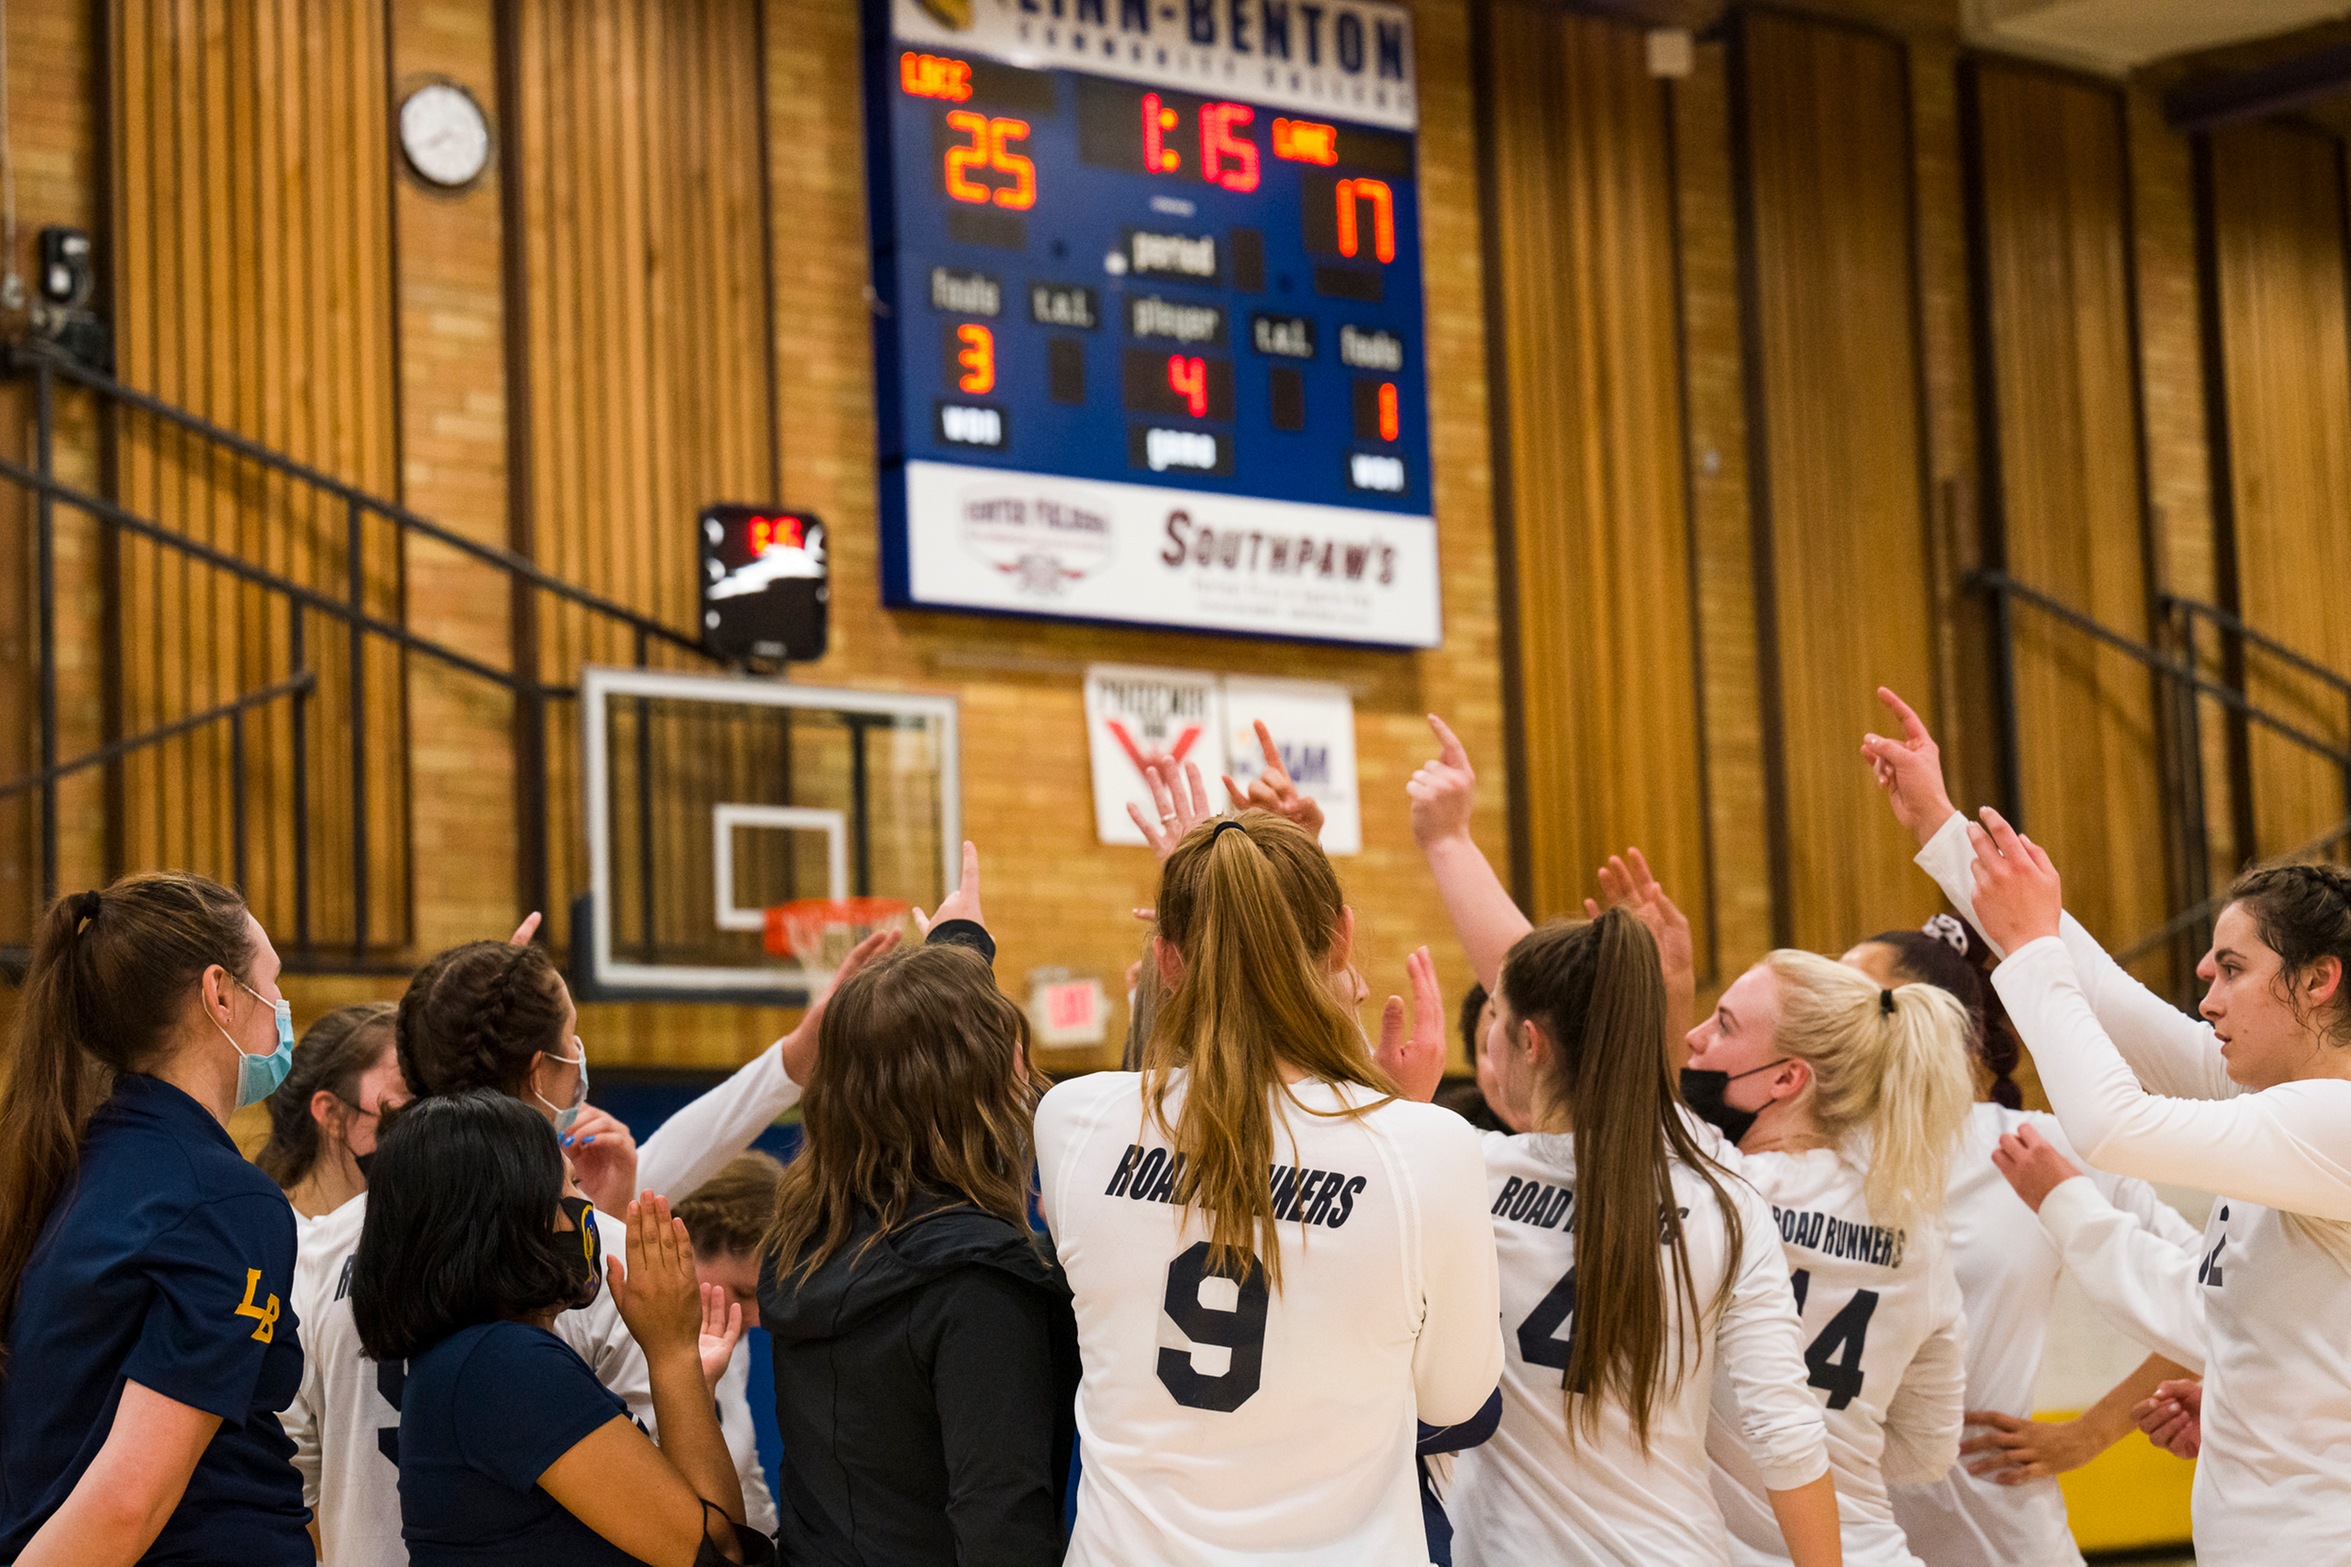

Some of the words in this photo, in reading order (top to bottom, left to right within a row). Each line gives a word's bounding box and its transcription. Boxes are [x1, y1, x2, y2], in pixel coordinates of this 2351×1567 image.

[1018, 0, 1405, 81] N-BENTON
[945, 110, 1037, 211] 25
[957, 323, 995, 394] 3
[1168, 354, 1207, 417] 4
[1378, 383, 1399, 441] 1
[1491, 1176, 1573, 1229] ROAD
[1772, 1205, 1825, 1250] ROAD
[1822, 1216, 1905, 1269] RUNNERS
[1156, 1240, 1272, 1413] 9
[1517, 1265, 1588, 1394] 4
